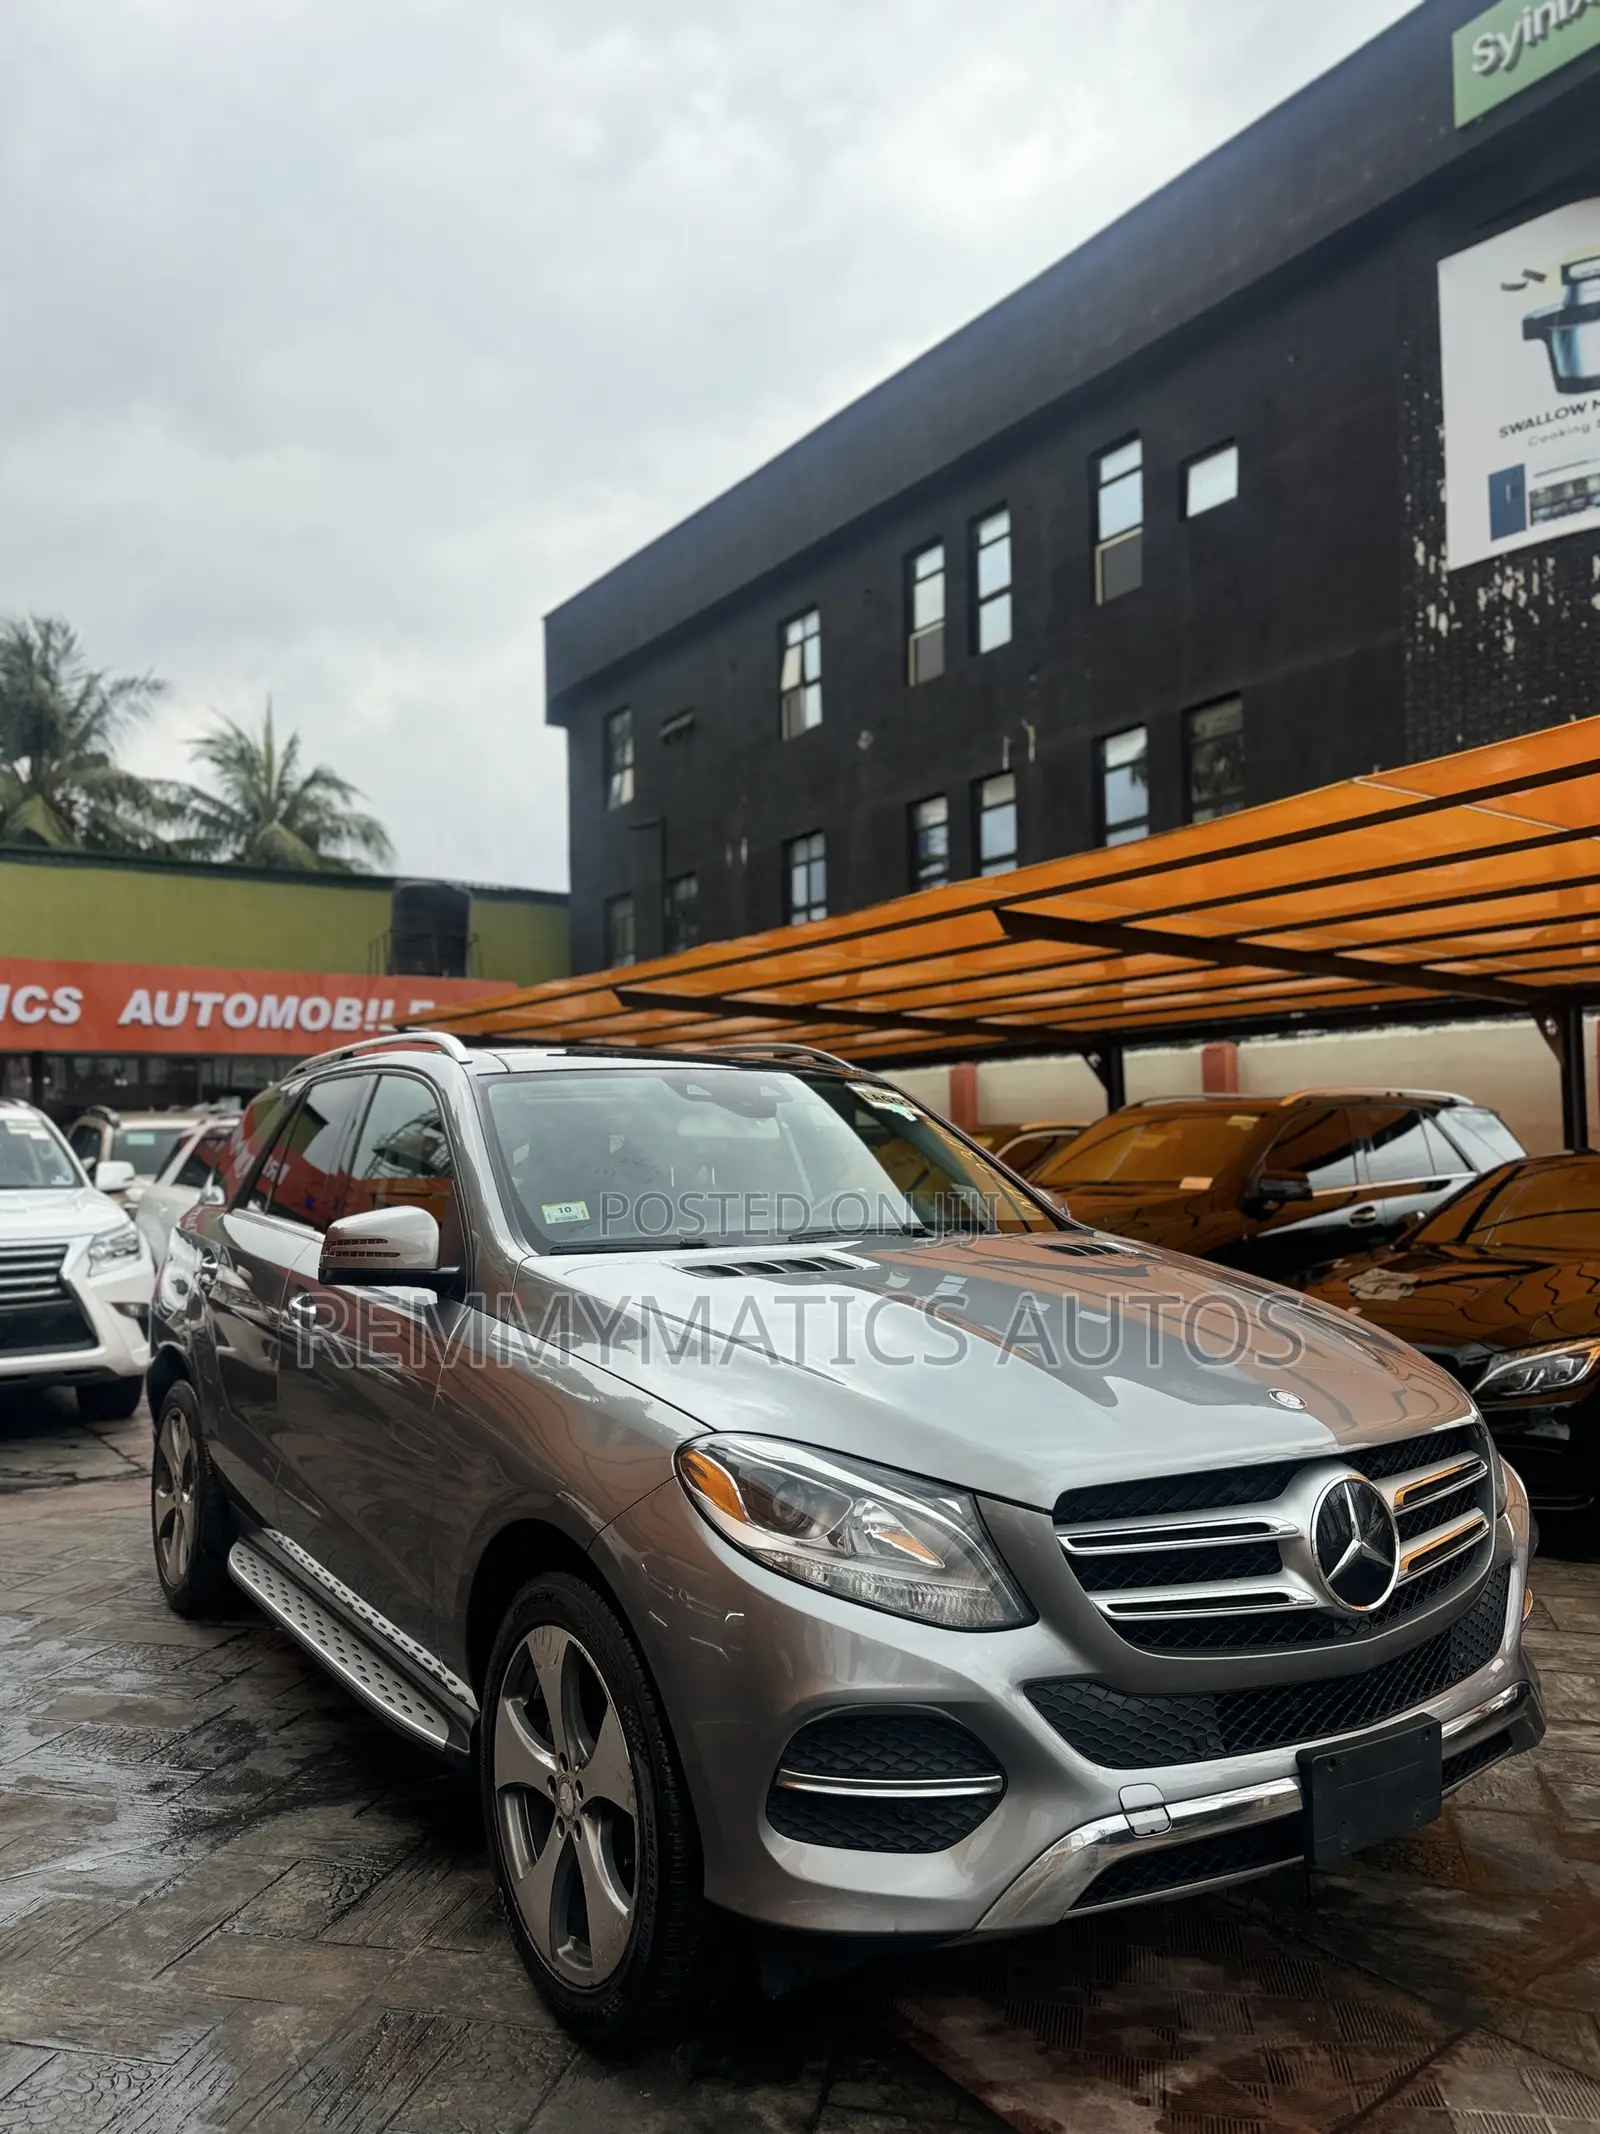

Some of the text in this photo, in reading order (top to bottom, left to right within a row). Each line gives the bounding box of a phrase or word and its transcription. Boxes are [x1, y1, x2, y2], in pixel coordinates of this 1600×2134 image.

[1472, 0, 1592, 73] Syin
[1499, 401, 1587, 439] SWALLOW
[1528, 423, 1590, 447] Cooking
